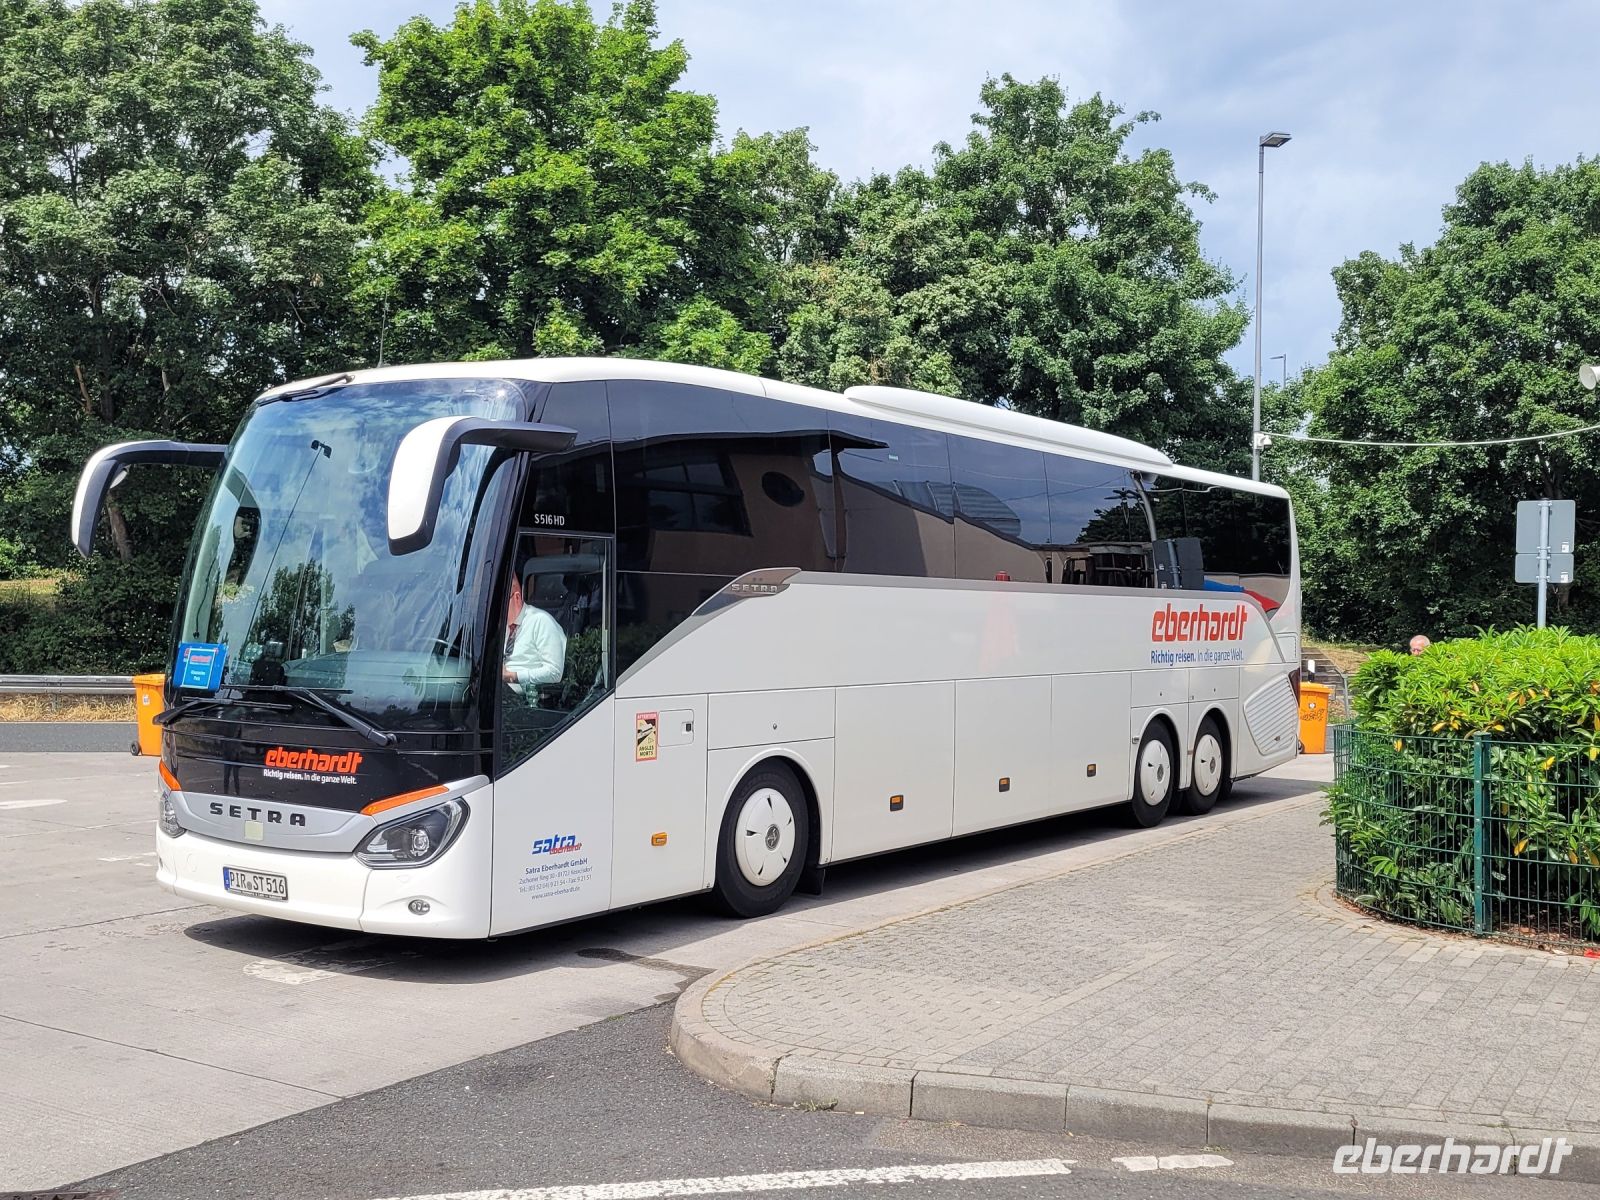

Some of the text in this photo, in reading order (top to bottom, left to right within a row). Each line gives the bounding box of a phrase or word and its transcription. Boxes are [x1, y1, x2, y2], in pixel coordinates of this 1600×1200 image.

[534, 513, 564, 526] S 516 HD
[731, 584, 778, 592] SETRA
[1152, 603, 1247, 642] eberhardt
[1150, 648, 1244, 666] Richtig reisen. In die ganze Welt.
[265, 746, 362, 774] eberhardt
[263, 768, 283, 780] Richtig
[284, 771, 304, 780] reisen.
[311, 773, 320, 782] die
[321, 776, 340, 784] ganze
[340, 776, 358, 784] Welt.
[210, 802, 305, 826] SETRA
[532, 834, 576, 854] satra
[542, 861, 570, 872] Eberhardt
[570, 858, 588, 866] GmbH
[230, 871, 246, 889] PIR
[252, 875, 264, 892] ST
[266, 878, 285, 894] 516
